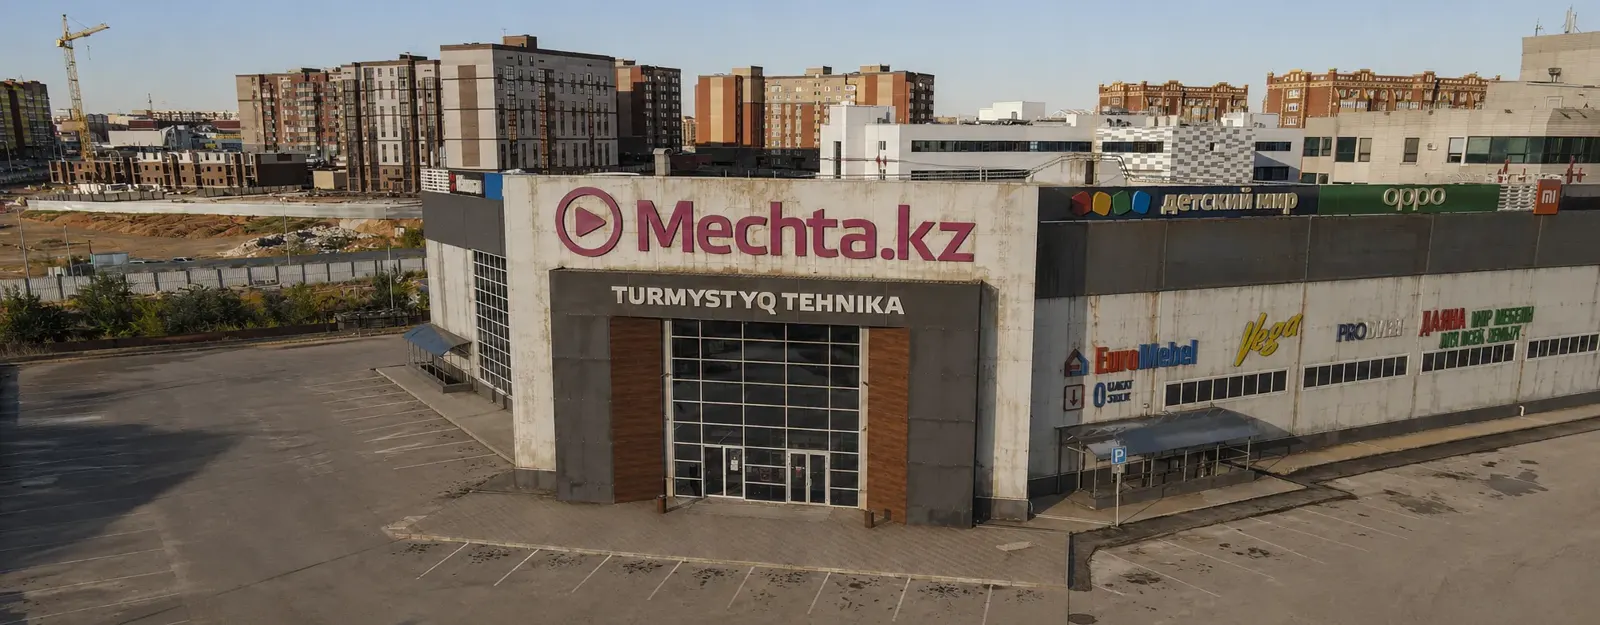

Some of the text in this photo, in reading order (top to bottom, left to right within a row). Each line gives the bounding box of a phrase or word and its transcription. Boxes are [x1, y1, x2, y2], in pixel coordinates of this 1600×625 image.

[1160, 187, 1298, 214] детский мир
[637, 200, 976, 262] Mechta.kz
[611, 286, 905, 315] TURMYSTYQ TEHNIKA
[1418, 308, 1466, 337] ДАЯНА
[1234, 312, 1303, 367] Vega
[1095, 340, 1198, 374] EuroMebel
[1115, 449, 1123, 463] P
